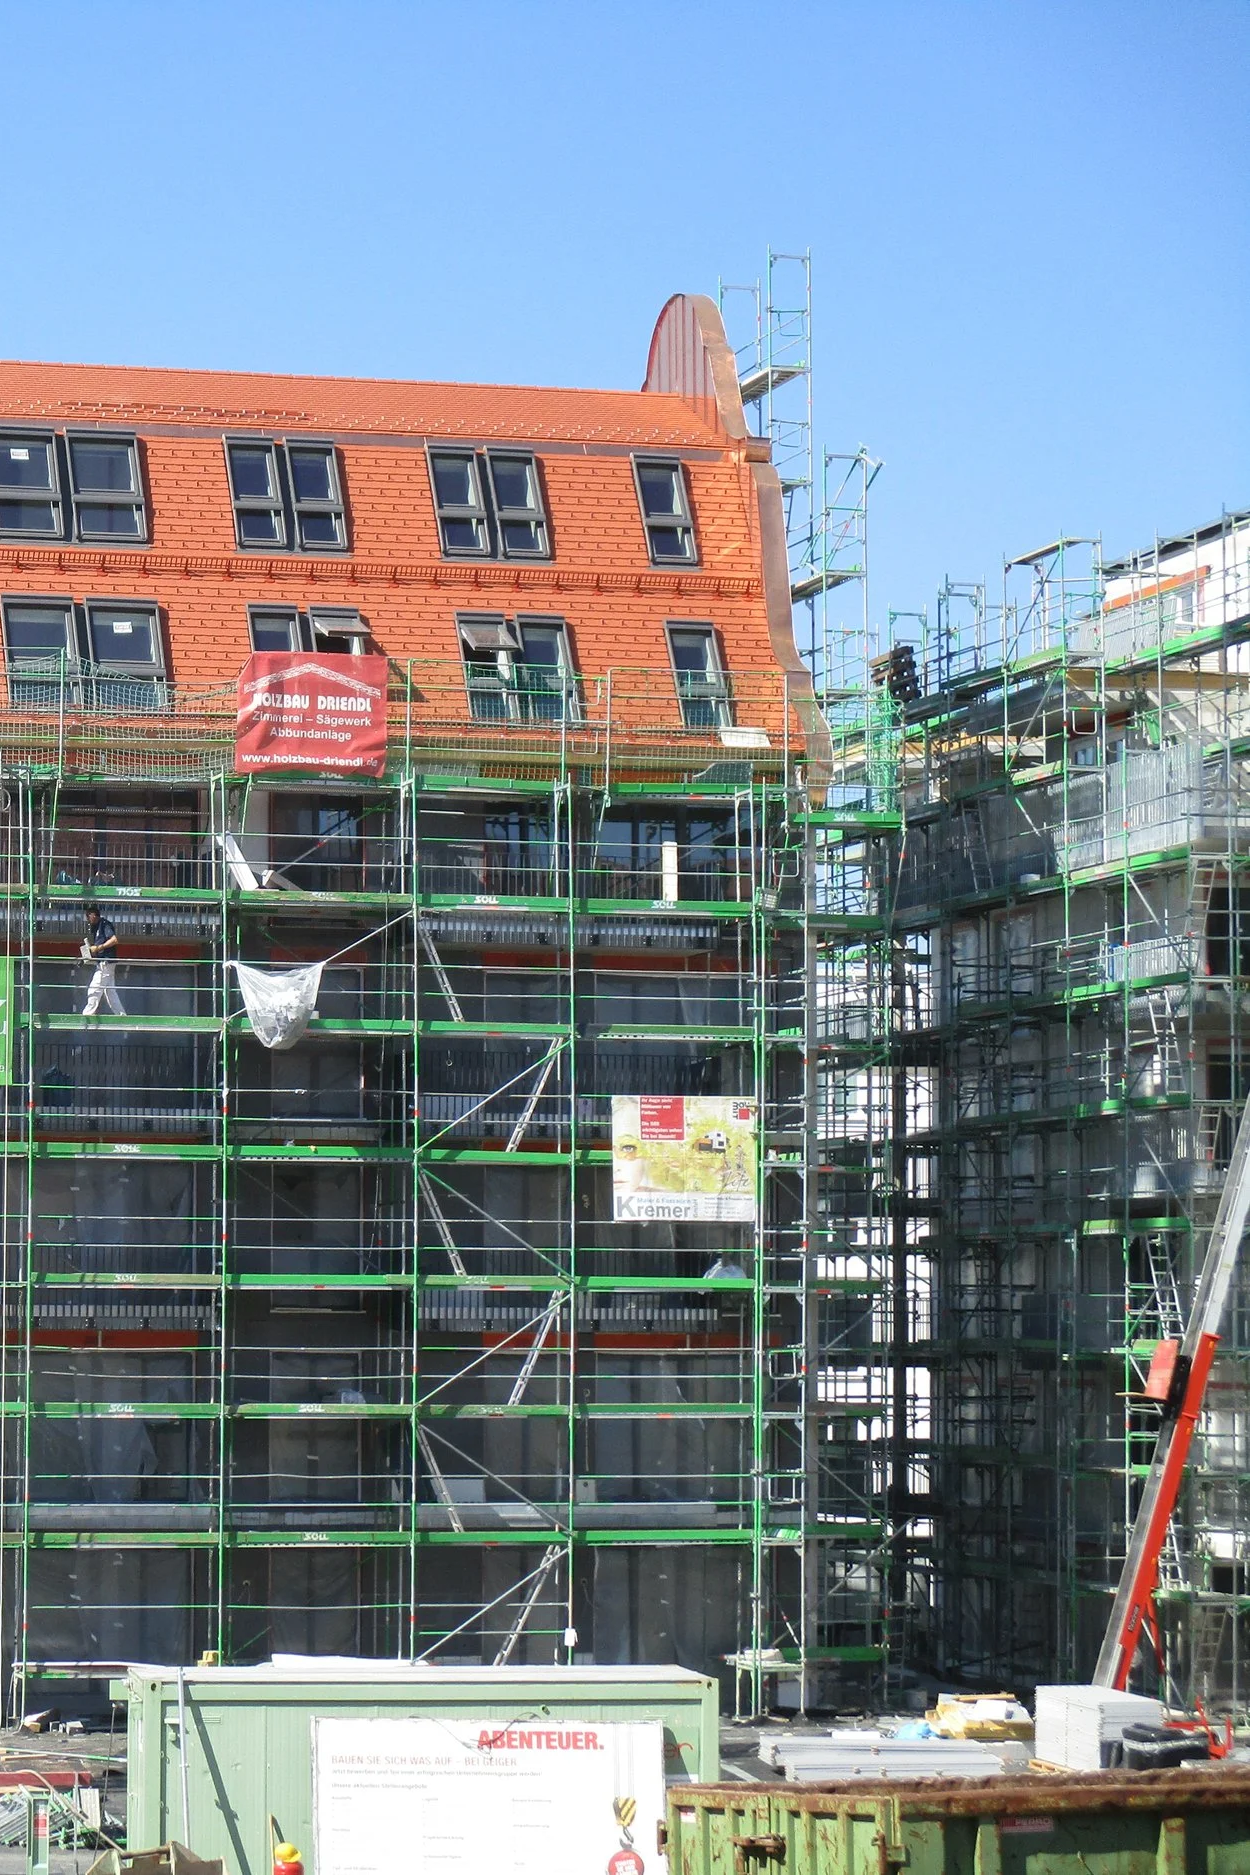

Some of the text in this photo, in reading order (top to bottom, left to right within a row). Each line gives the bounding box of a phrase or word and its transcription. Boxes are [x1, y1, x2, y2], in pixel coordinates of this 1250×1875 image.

[253, 693, 372, 712] HOLZBAU DRIENDL
[253, 711, 304, 724] Zimmerei
[316, 714, 372, 727] Sägewerk
[270, 727, 352, 742] Abbundanlage
[242, 753, 378, 767] www.holzbau-driendl.de
[616, 1196, 691, 1218] Kremer
[477, 1730, 605, 1750] ABENTEUER.
[332, 1755, 364, 1765] BAUEN
[366, 1755, 381, 1765] SIE
[384, 1755, 407, 1765] SICH
[409, 1755, 432, 1765] WAS
[435, 1756, 453, 1766] AUF
